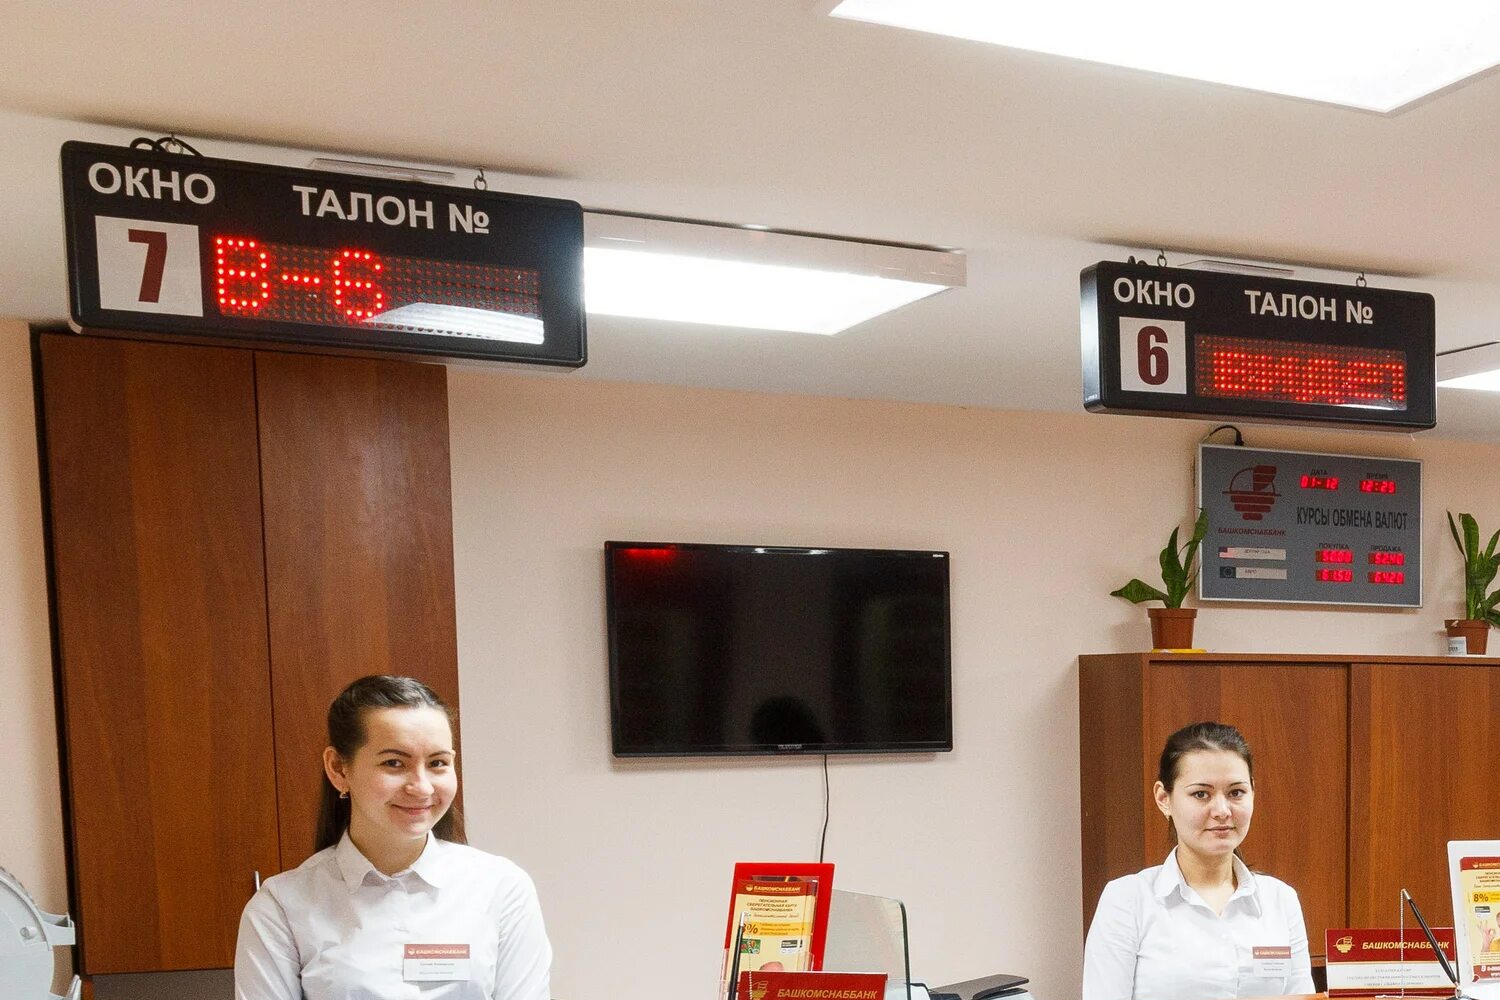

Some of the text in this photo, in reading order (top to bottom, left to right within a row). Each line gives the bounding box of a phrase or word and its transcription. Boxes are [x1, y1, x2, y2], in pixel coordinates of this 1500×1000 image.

[88, 161, 216, 205] ОКНО
[293, 185, 490, 234] ТАЛОН №
[128, 229, 168, 304] 7
[1113, 277, 1195, 308] ОКНО
[1244, 289, 1373, 325] ТАЛОН №
[1137, 326, 1169, 386] 6
[1218, 527, 1287, 537] БАШКОМСНАББАНК
[1297, 507, 1407, 530] КУРСЫ ОБМЕНА ВАЛЮТ
[1473, 893, 1489, 902] 8%
[1362, 941, 1450, 950] БАШКОМСНАББНК
[777, 987, 879, 1000] БАШКОМСНАББАНК
